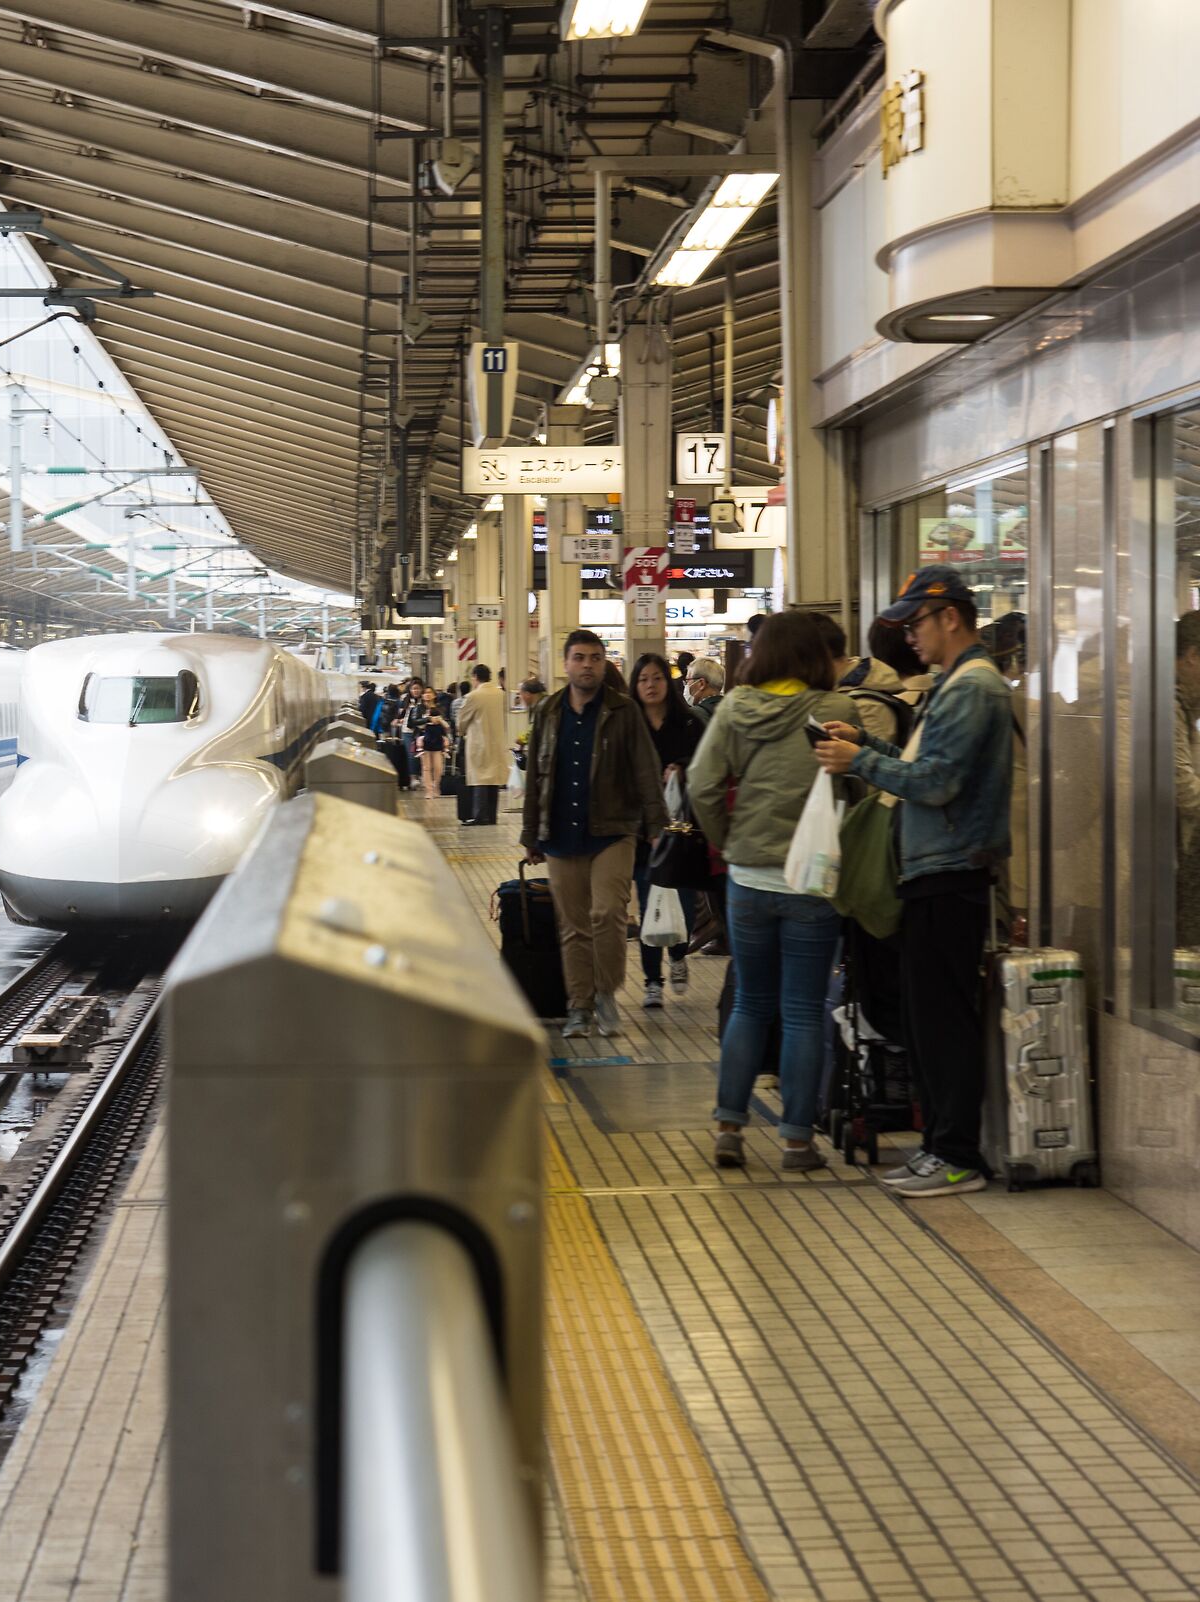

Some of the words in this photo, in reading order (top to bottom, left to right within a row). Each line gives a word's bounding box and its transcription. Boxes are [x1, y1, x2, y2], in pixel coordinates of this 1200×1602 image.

[484, 350, 504, 370] 11
[687, 443, 720, 473] 17
[520, 475, 563, 484] Escalator
[738, 503, 767, 533] 7
[635, 559, 658, 568] SOS
